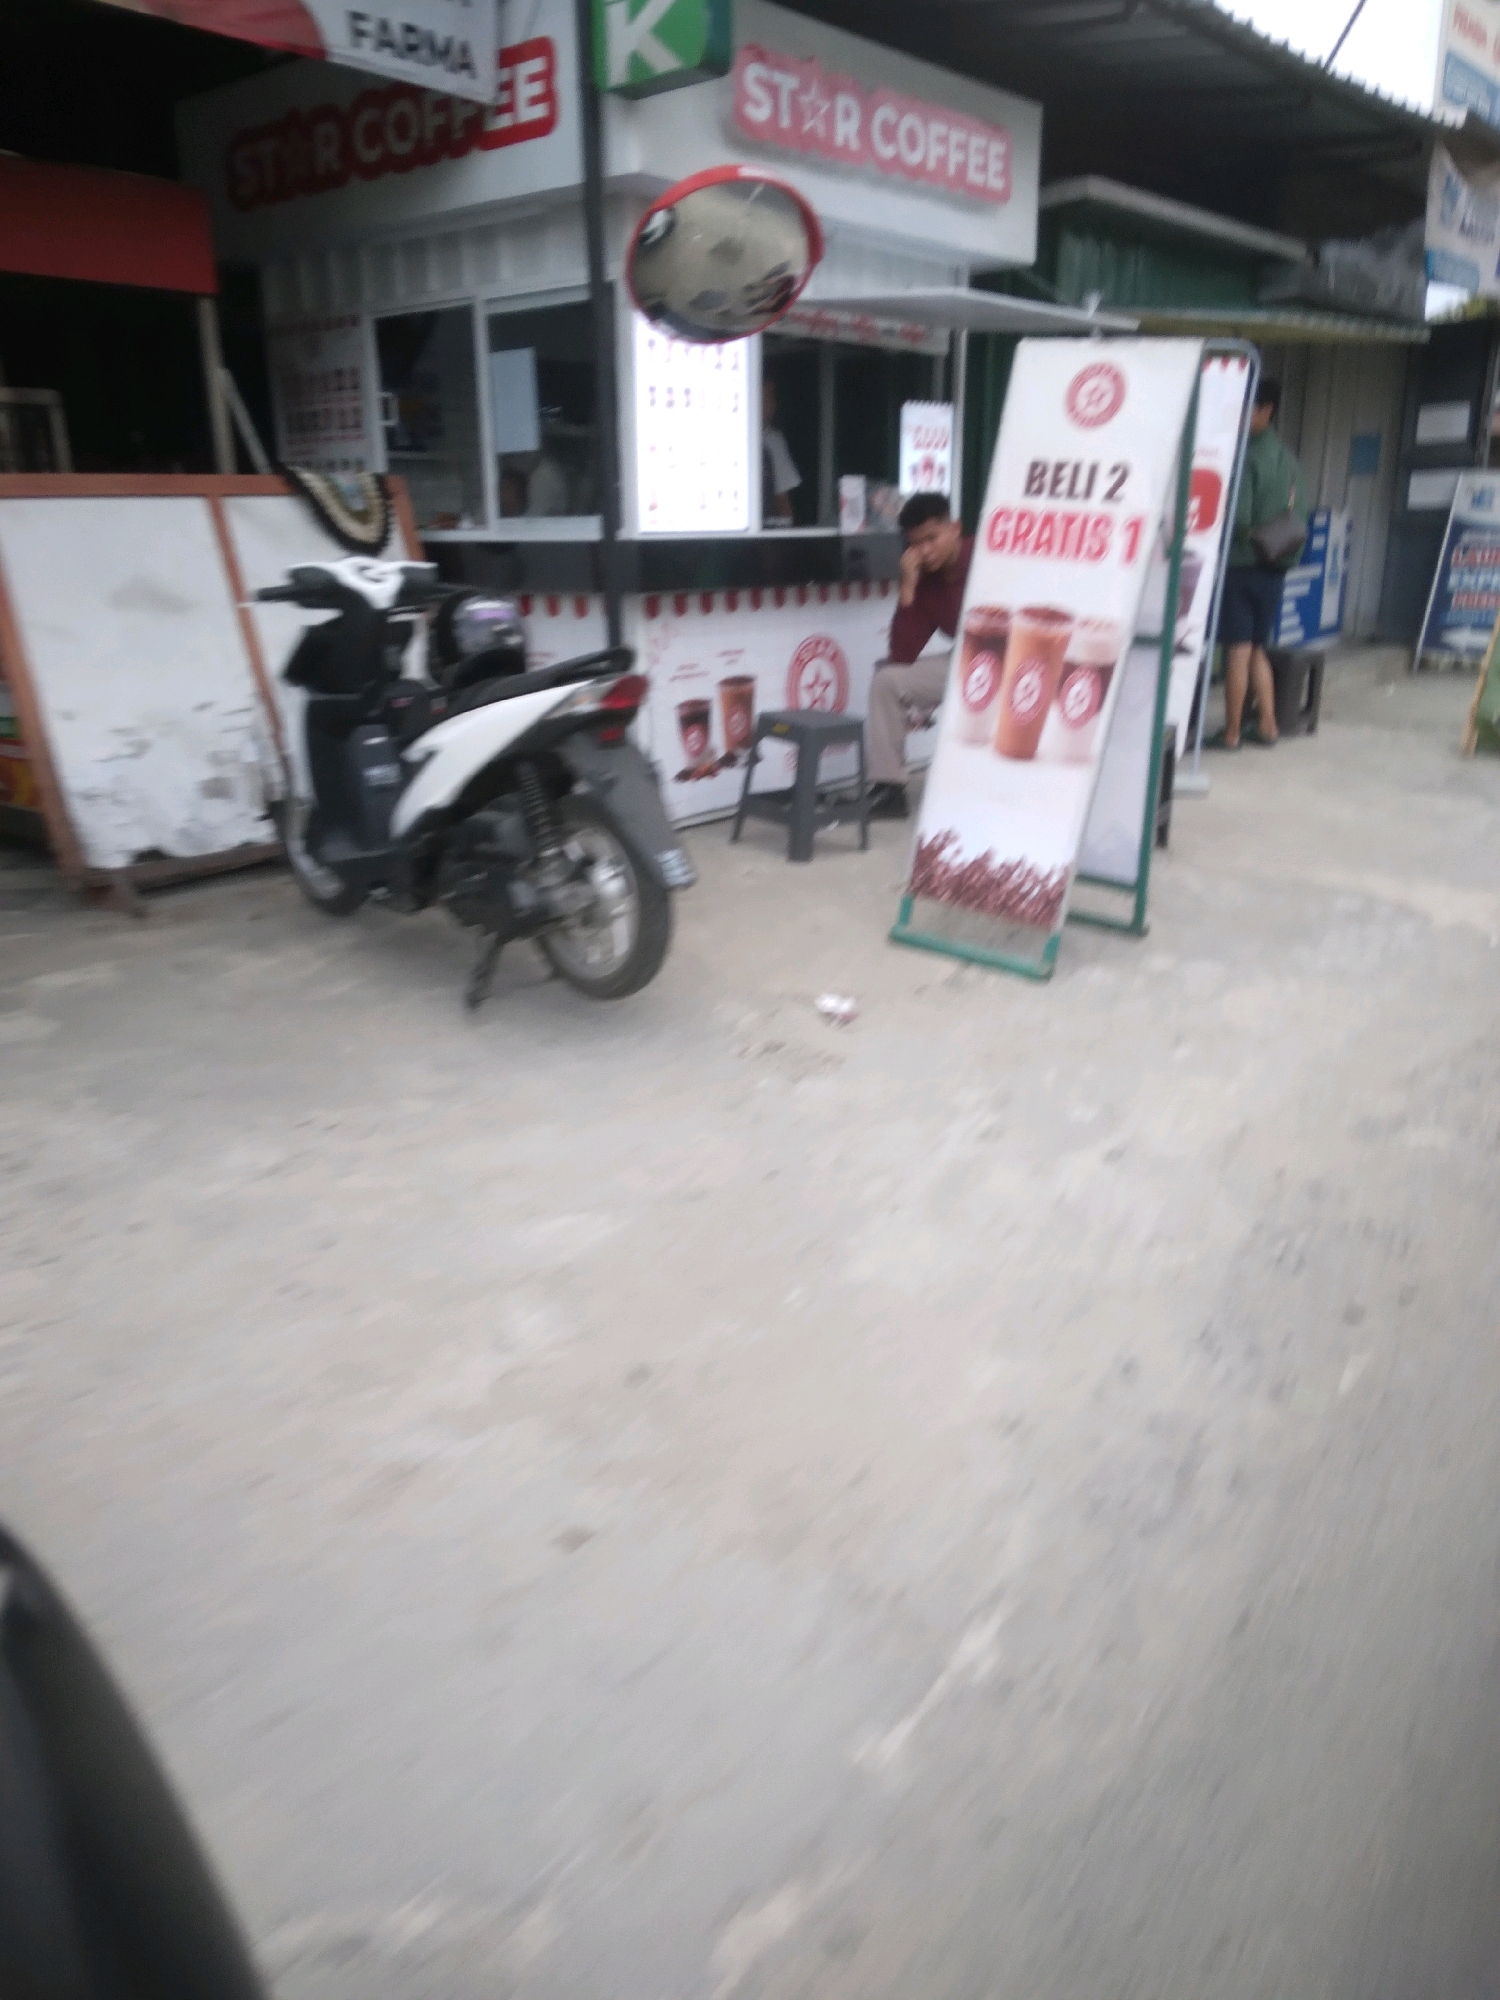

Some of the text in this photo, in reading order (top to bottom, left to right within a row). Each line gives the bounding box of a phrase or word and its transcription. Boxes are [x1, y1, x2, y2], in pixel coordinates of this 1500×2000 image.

[346, 10, 478, 80] FARMA
[606, 0, 684, 88] K
[872, 105, 1007, 191] COFFEE
[1024, 460, 1131, 502] BELI 2
[986, 506, 1146, 566] GRATIS 1
